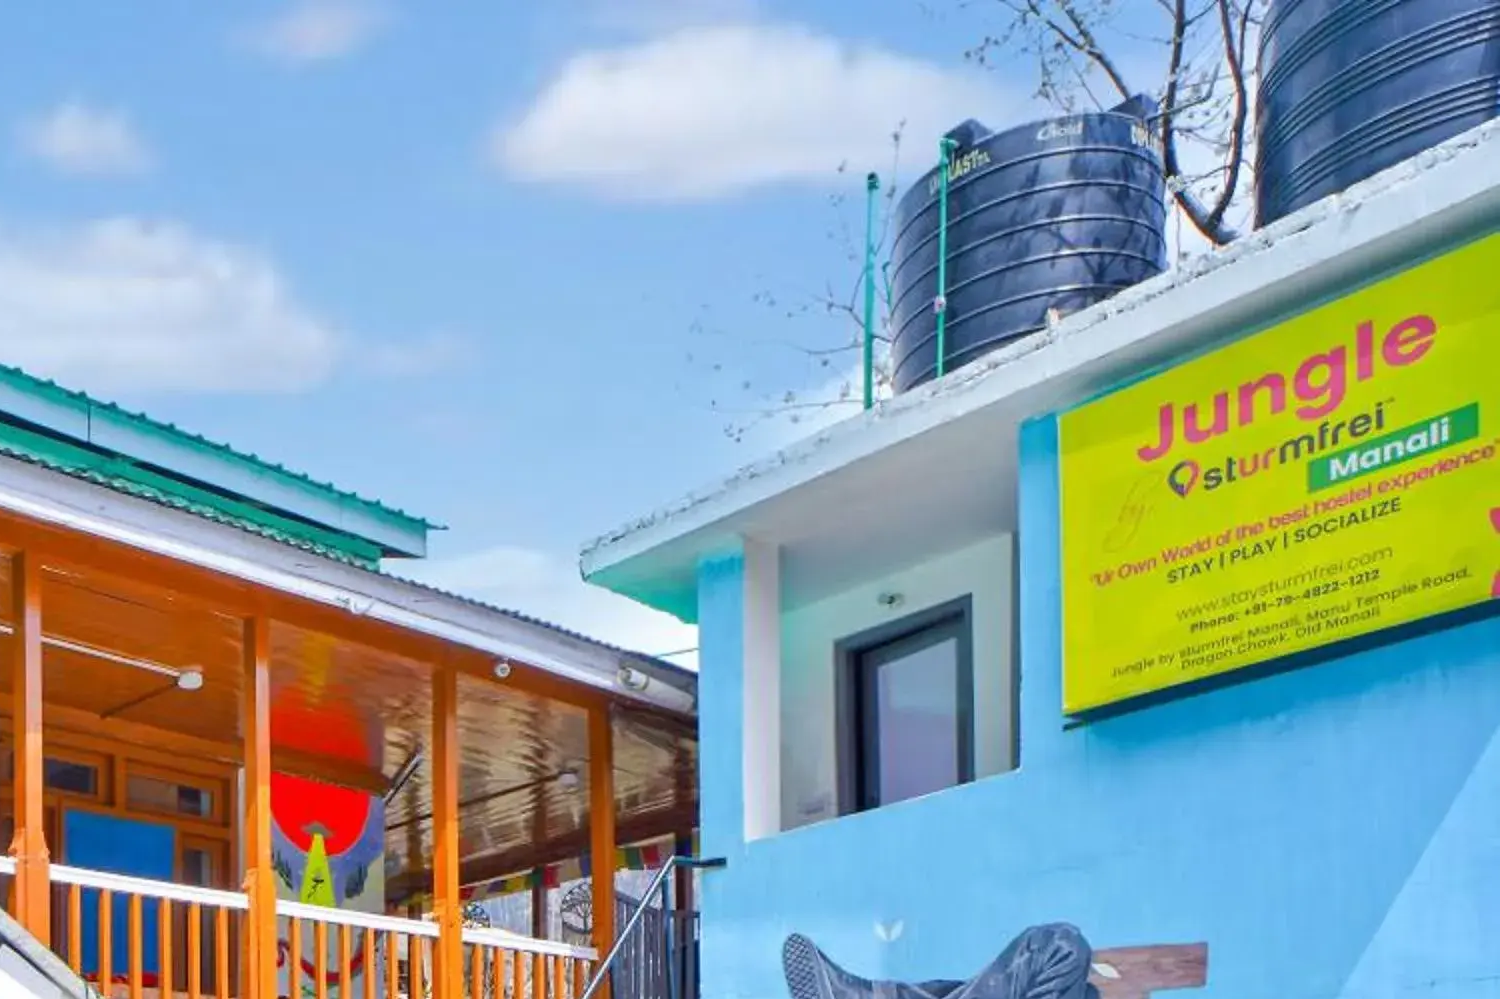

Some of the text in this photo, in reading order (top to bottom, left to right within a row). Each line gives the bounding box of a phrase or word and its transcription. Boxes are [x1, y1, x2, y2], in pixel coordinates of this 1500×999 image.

[1137, 314, 1437, 461] Jungle
[1203, 400, 1385, 490] sturmfrei
[1329, 417, 1451, 481] Manali
[1117, 557, 1157, 579] Own
[1161, 536, 1213, 563] World
[1216, 529, 1233, 546] of
[1235, 521, 1264, 541] the
[1268, 504, 1308, 530] best
[1313, 482, 1373, 515] hostel
[1167, 556, 1214, 584] STAY
[1230, 534, 1278, 564] PLAY
[1294, 497, 1402, 543] SOCIALIZE
[1295, 622, 1322, 640] Old
